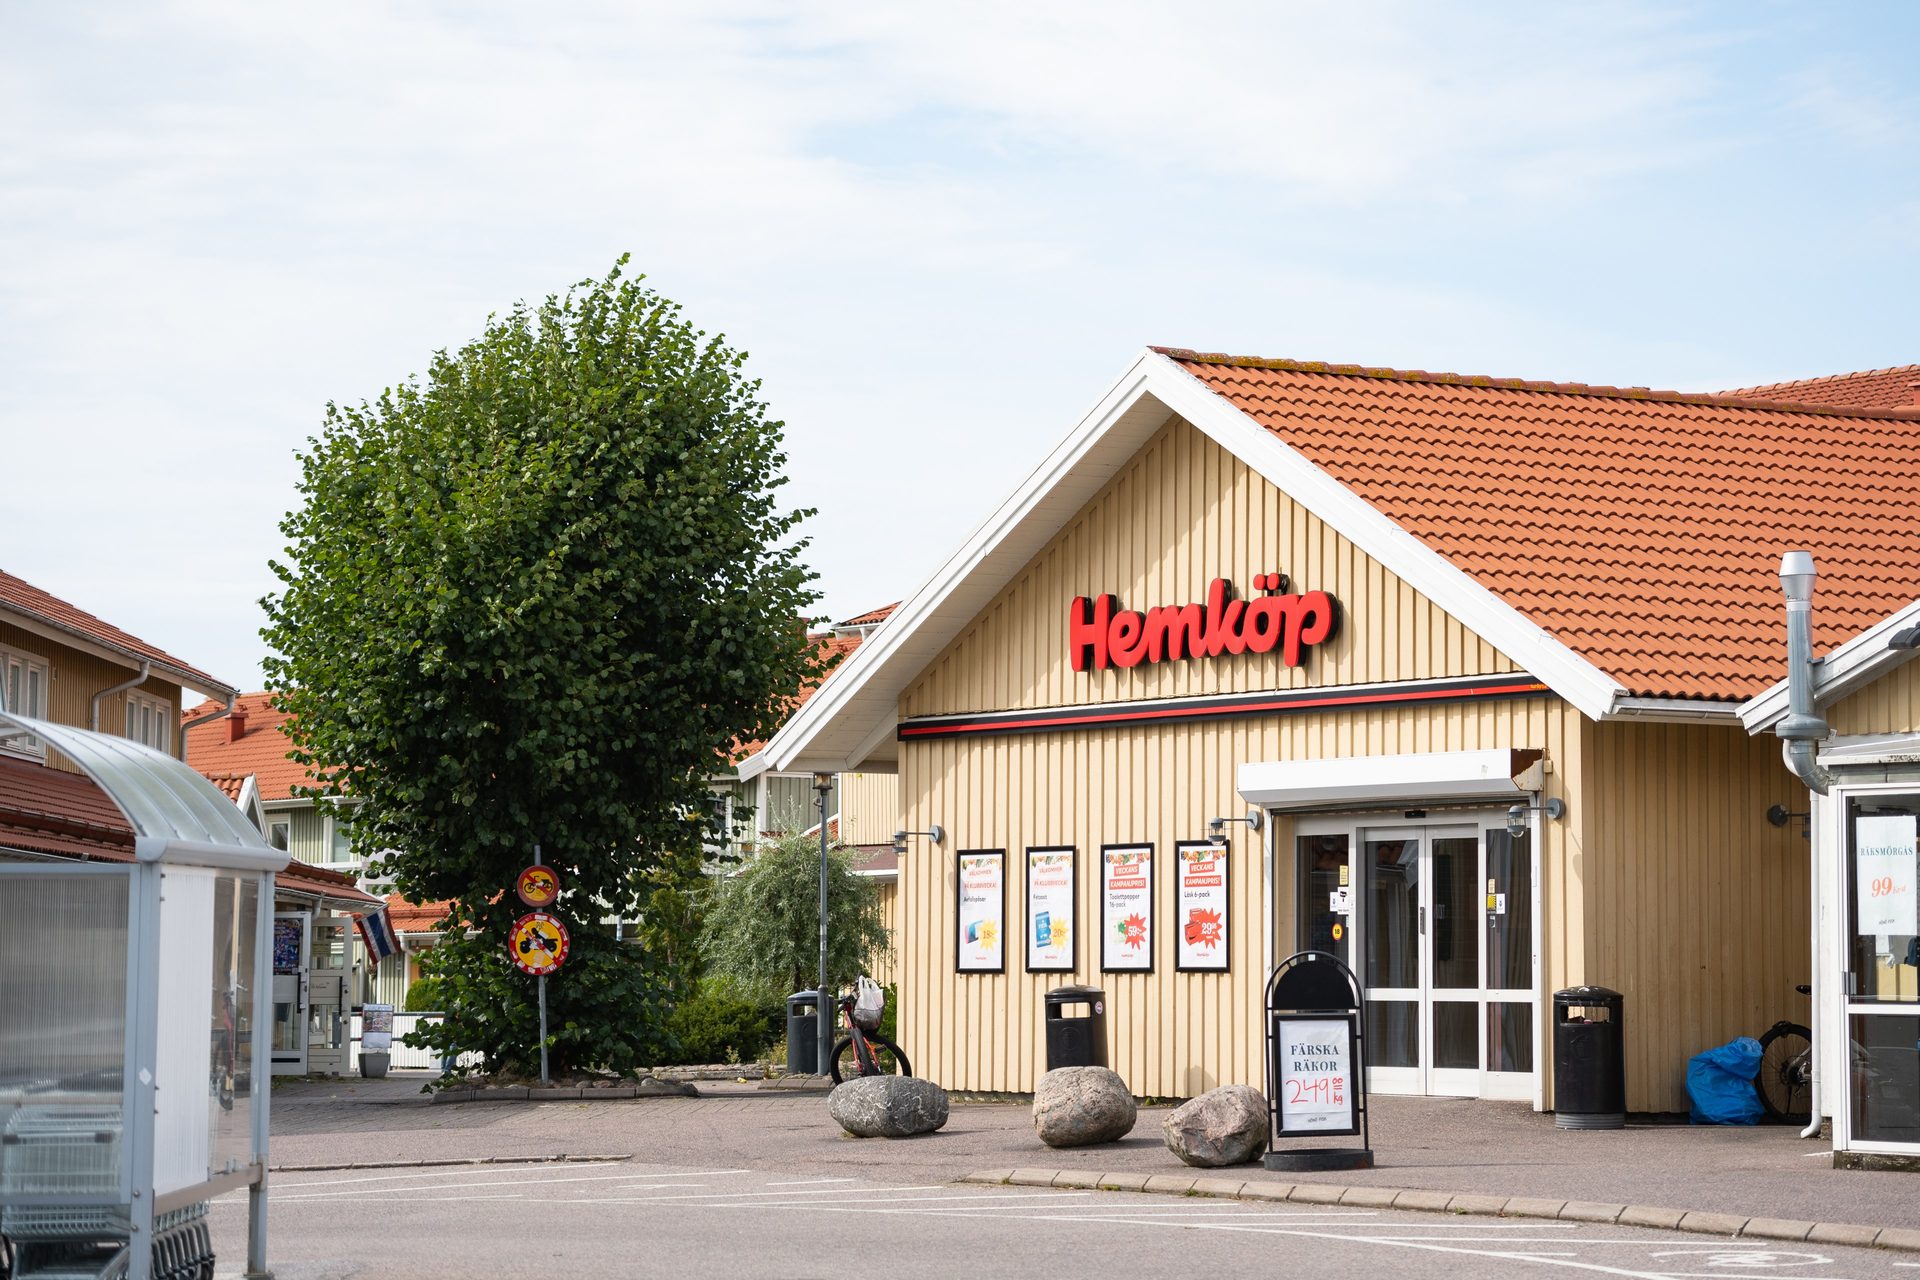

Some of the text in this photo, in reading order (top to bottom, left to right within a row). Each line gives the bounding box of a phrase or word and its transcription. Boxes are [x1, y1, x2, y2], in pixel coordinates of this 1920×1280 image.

[1070, 572, 1341, 672] Hemköp
[1872, 876, 1893, 898] 99
[1291, 1043, 1339, 1056] FÄRSKA
[1294, 1059, 1337, 1072] RÄKOR
[1285, 1078, 1329, 1104] 249
[1333, 1091, 1343, 1105] kg
